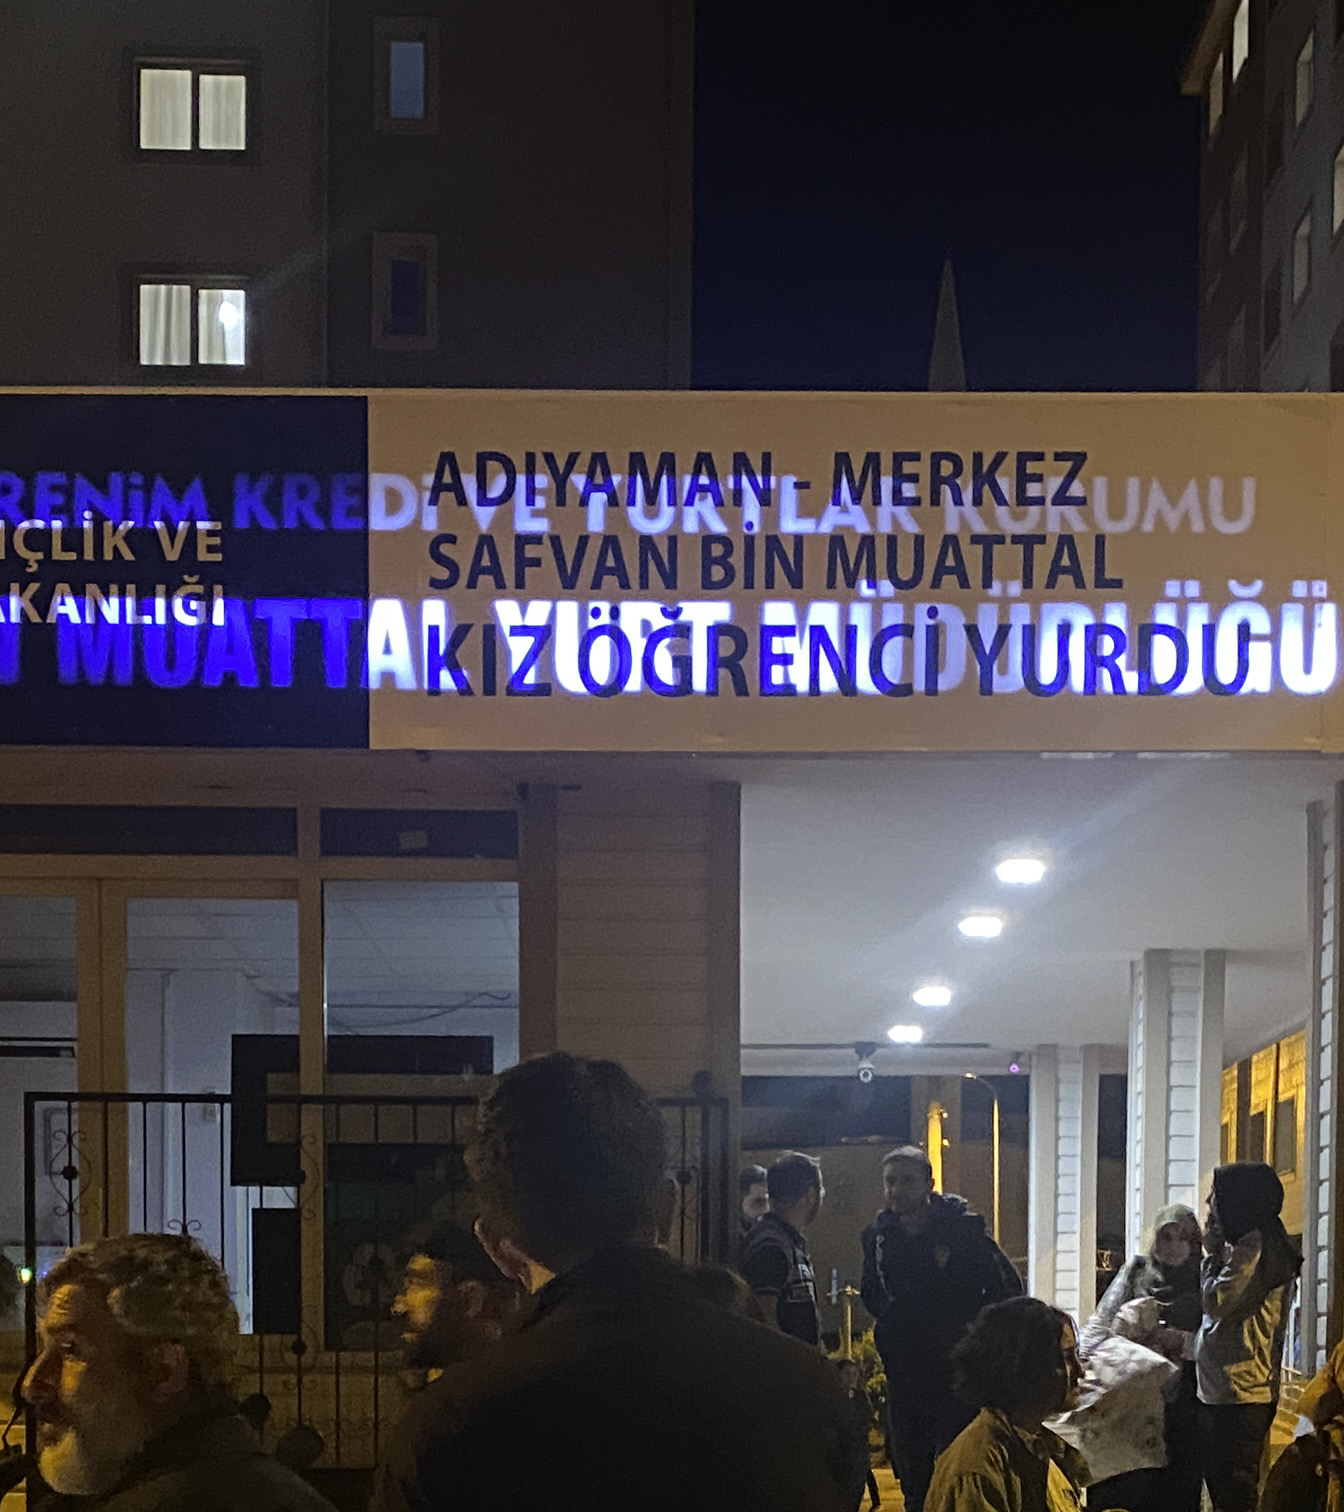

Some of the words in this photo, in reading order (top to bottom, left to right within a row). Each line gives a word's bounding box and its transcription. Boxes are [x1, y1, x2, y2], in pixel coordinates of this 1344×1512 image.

[427, 451, 772, 508] ADIYAMAN
[832, 451, 1088, 508] MERKEZ
[153, 519, 224, 562] VE
[427, 533, 678, 591] SAFVAN
[700, 520, 804, 591] BİN
[825, 533, 1124, 591] MUATTAL
[426, 622, 552, 697] KIZ
[578, 604, 940, 698] ÖĞRENCİ
[962, 622, 1251, 698] YURDU
